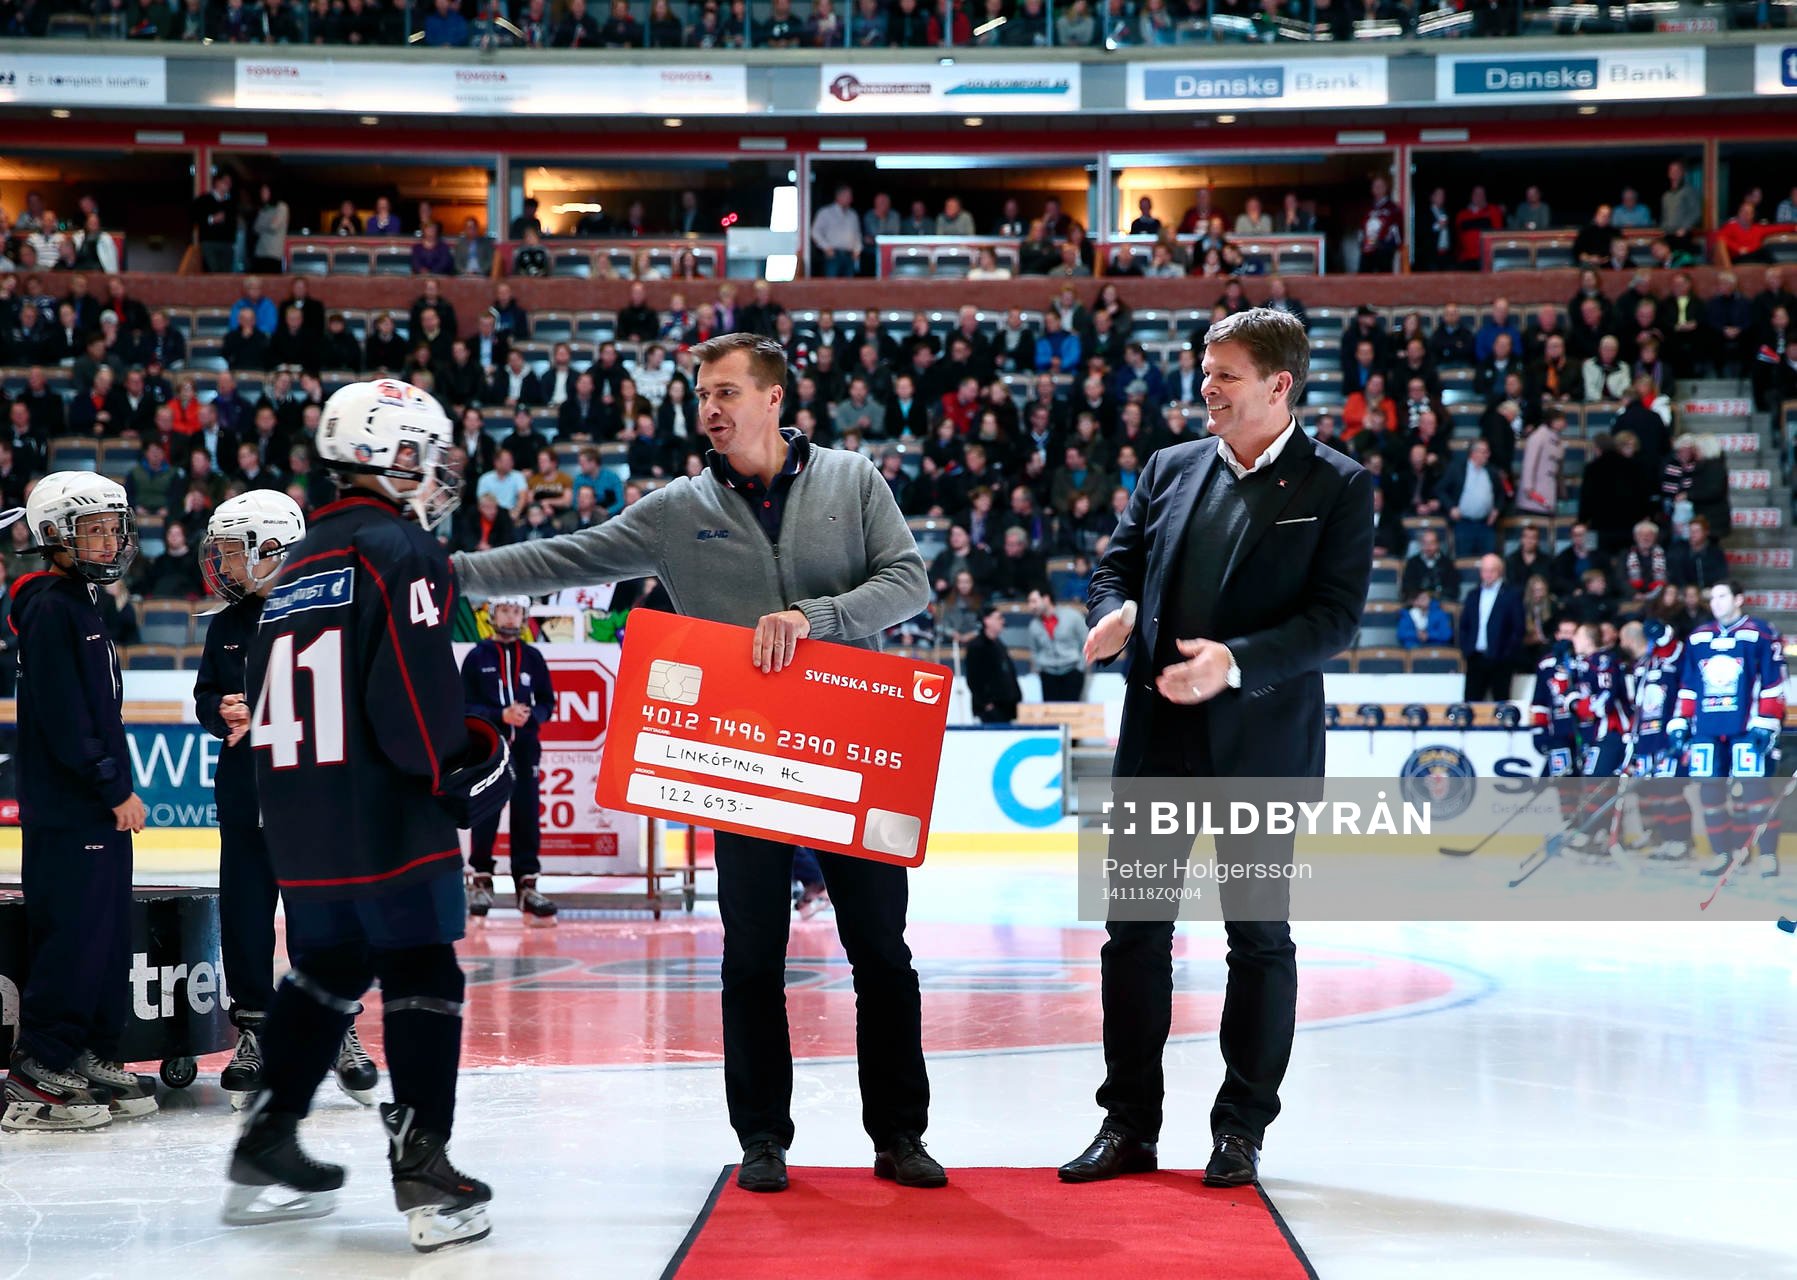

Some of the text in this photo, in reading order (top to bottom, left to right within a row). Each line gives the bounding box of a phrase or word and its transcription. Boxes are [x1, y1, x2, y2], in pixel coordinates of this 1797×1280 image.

[246, 65, 299, 79] TOYOTA
[455, 70, 507, 82] TOYOTA
[1174, 72, 1363, 98] Danske Bank
[1485, 63, 1680, 90] Danske Bank
[409, 577, 440, 628] 4
[804, 669, 905, 699] SVENSKA SPEL
[250, 629, 346, 770] 41
[641, 704, 903, 770] 4012 7496 2390 5185
[126, 733, 224, 788] WE
[781, 766, 804, 783] HC
[660, 785, 753, 812] 122 693:-
